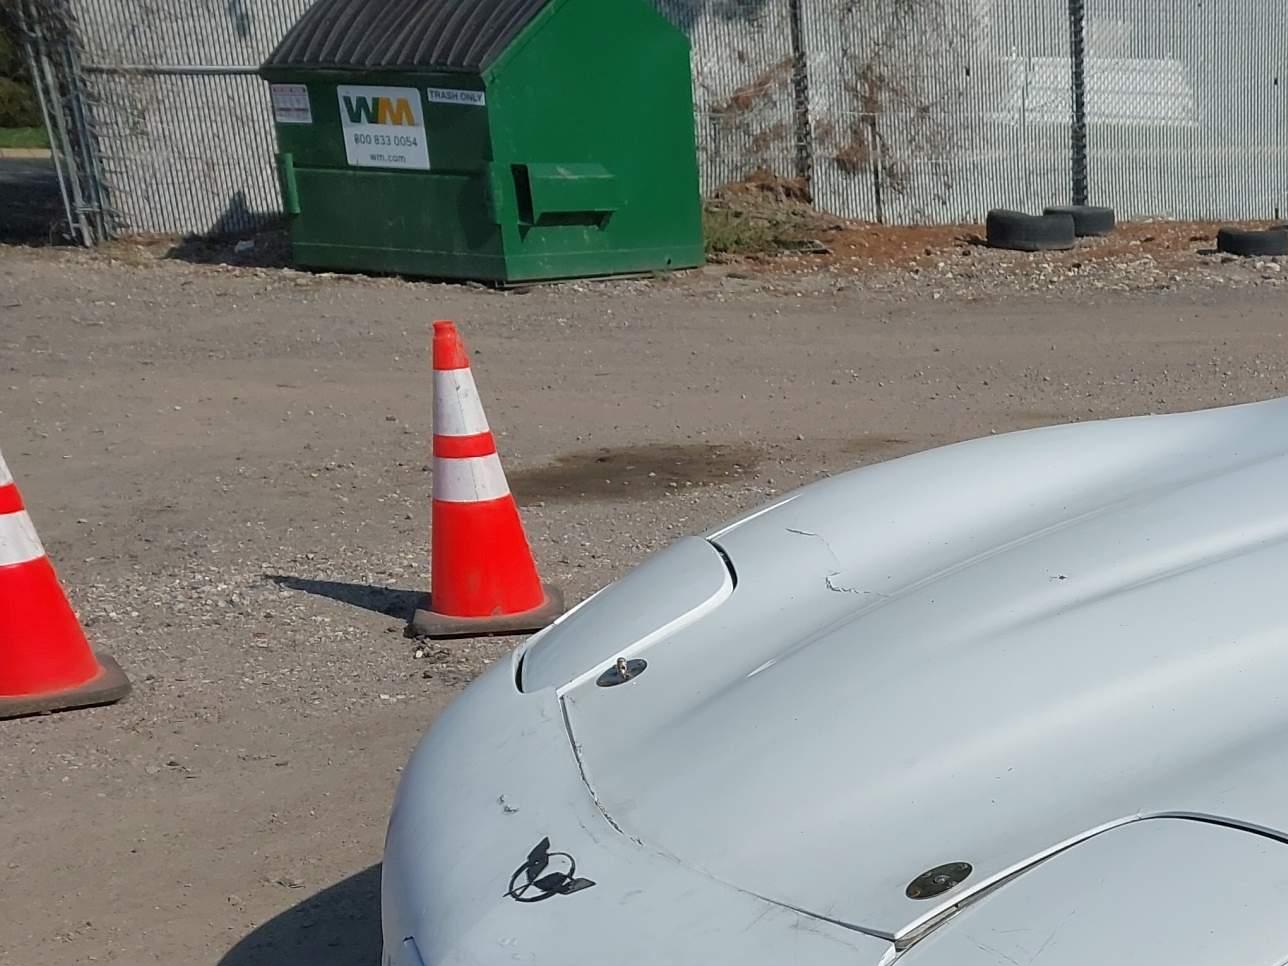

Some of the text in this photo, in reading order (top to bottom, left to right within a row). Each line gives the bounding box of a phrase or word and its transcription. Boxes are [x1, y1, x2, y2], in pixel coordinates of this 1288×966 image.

[430, 90, 482, 102] TRASH ONLY
[342, 95, 415, 126] WM
[354, 133, 417, 147] 800 833 0054
[369, 153, 406, 163] wm.com
